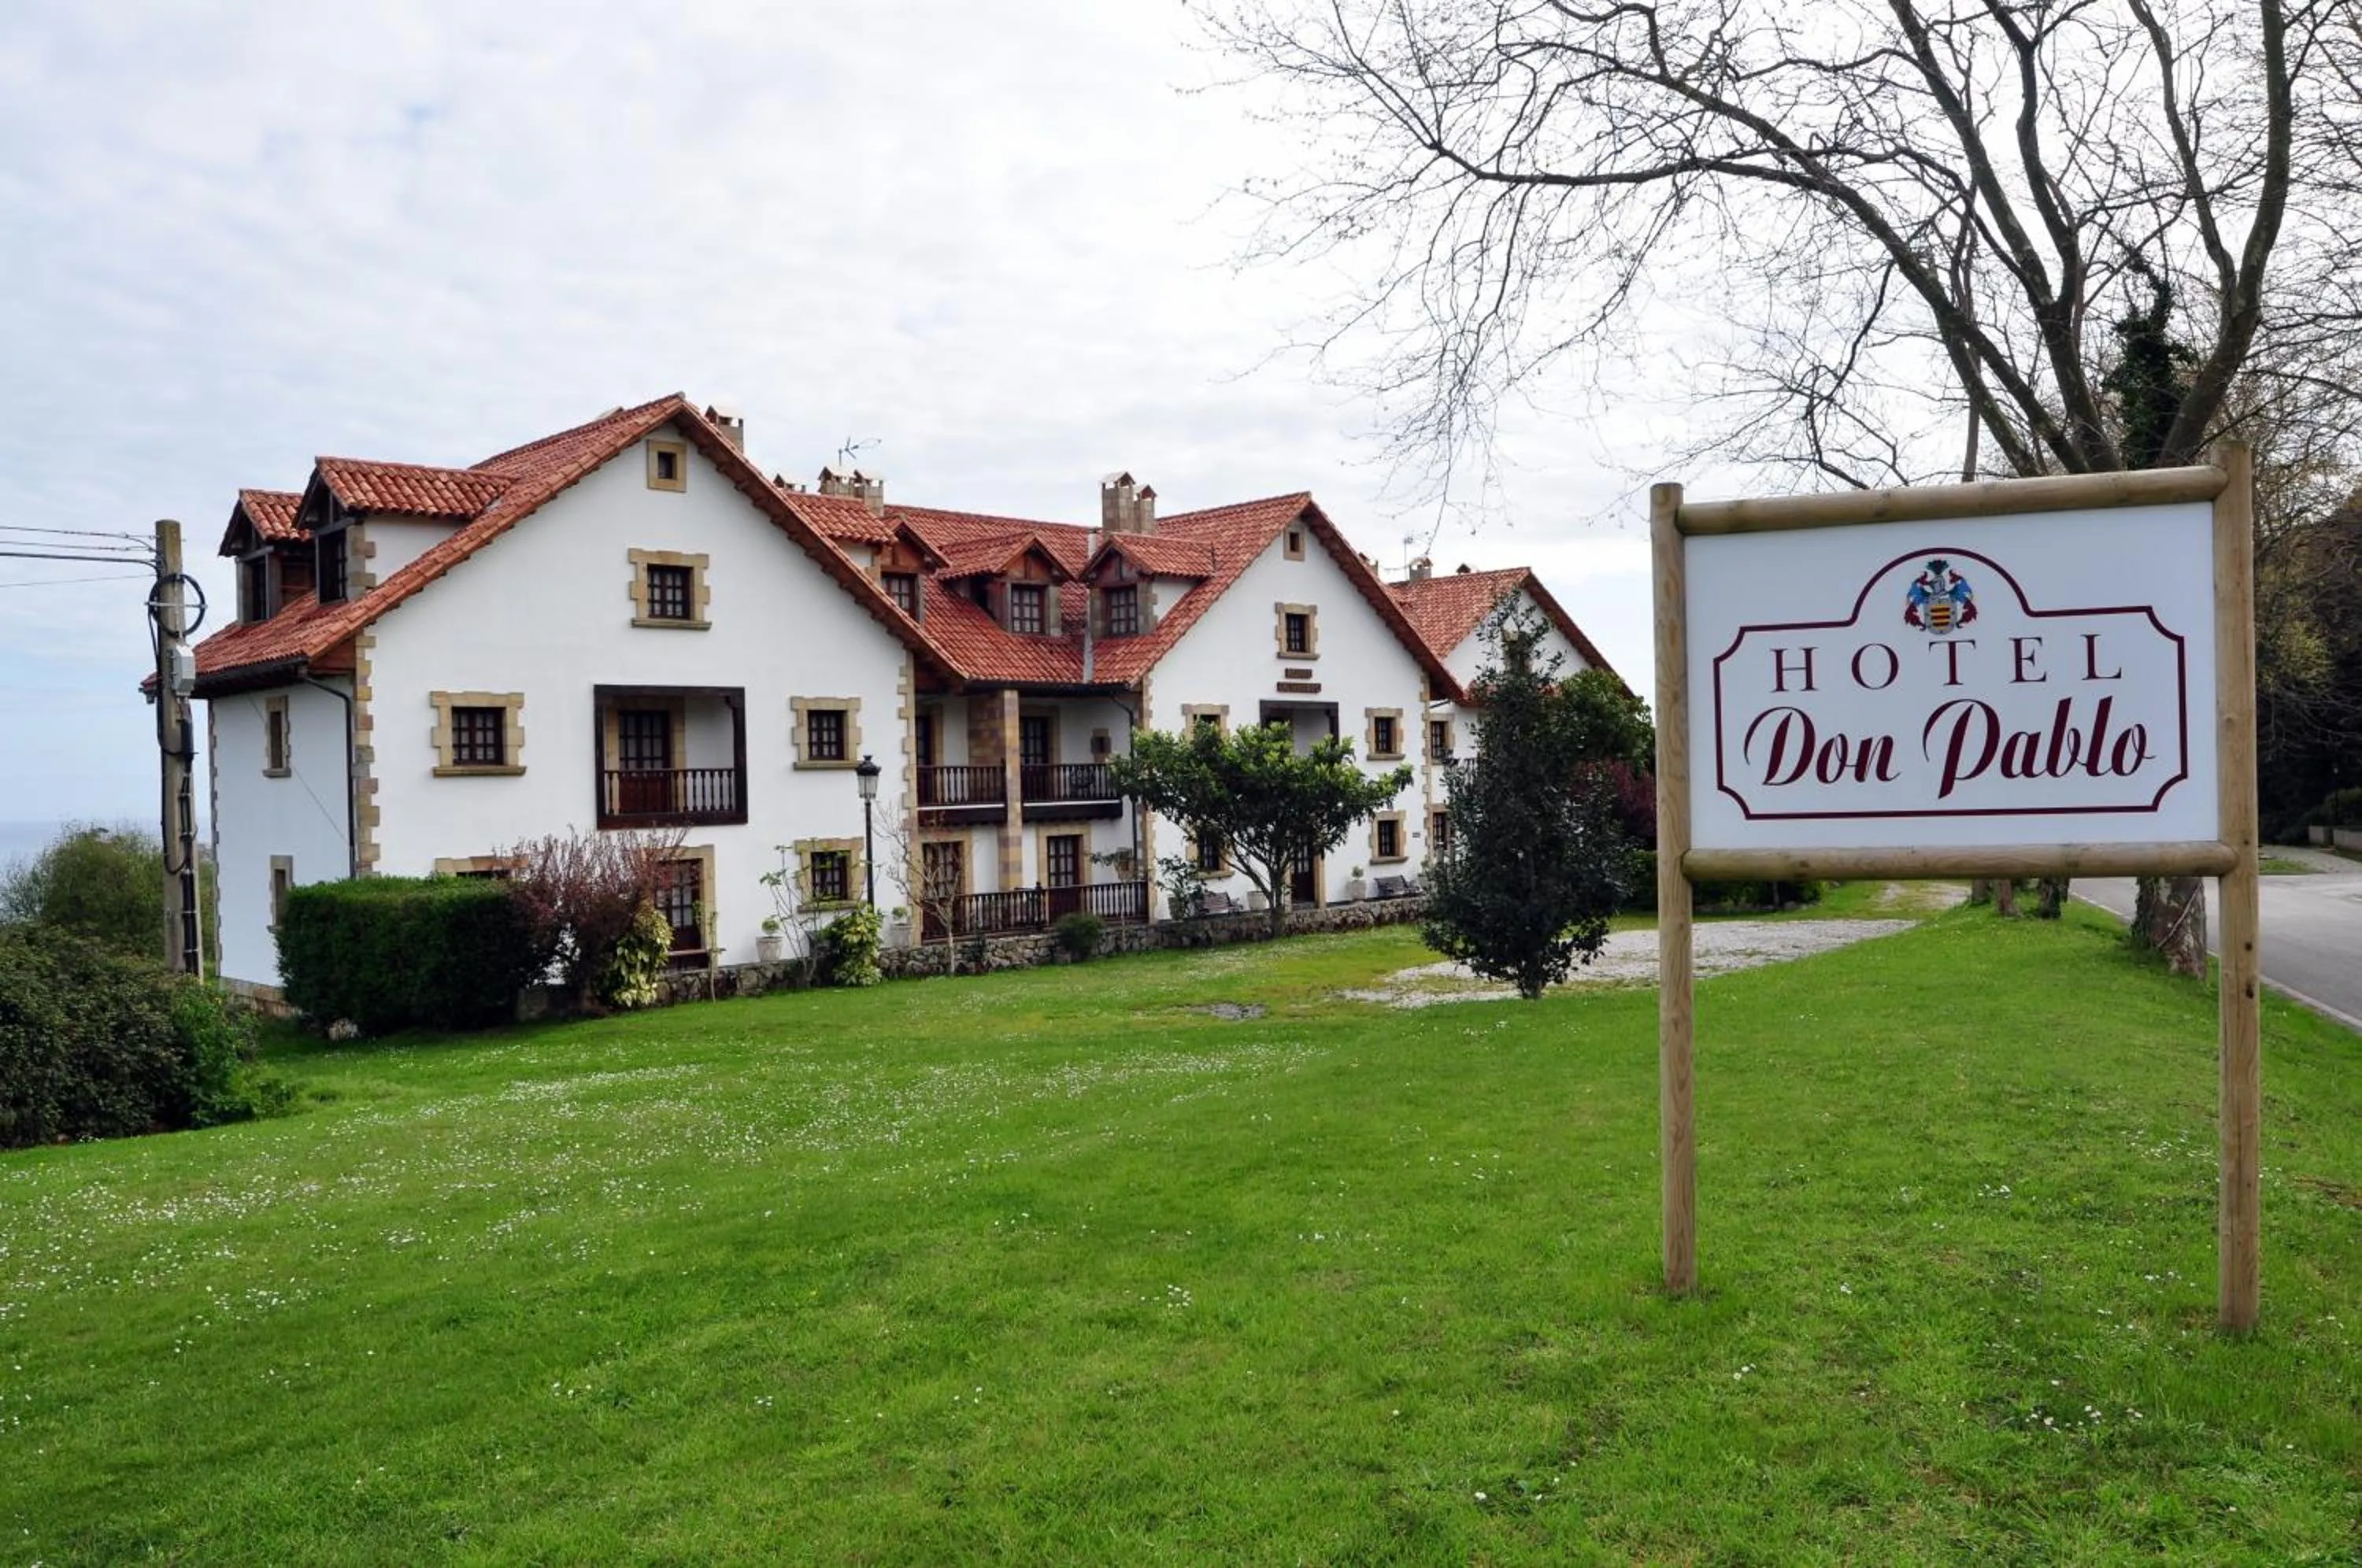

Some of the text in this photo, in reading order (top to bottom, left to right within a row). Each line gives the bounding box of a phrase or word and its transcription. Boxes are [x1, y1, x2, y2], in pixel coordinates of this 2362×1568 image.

[1770, 634, 2123, 692] HOTEL
[1744, 695, 2157, 799] Don Pablo
